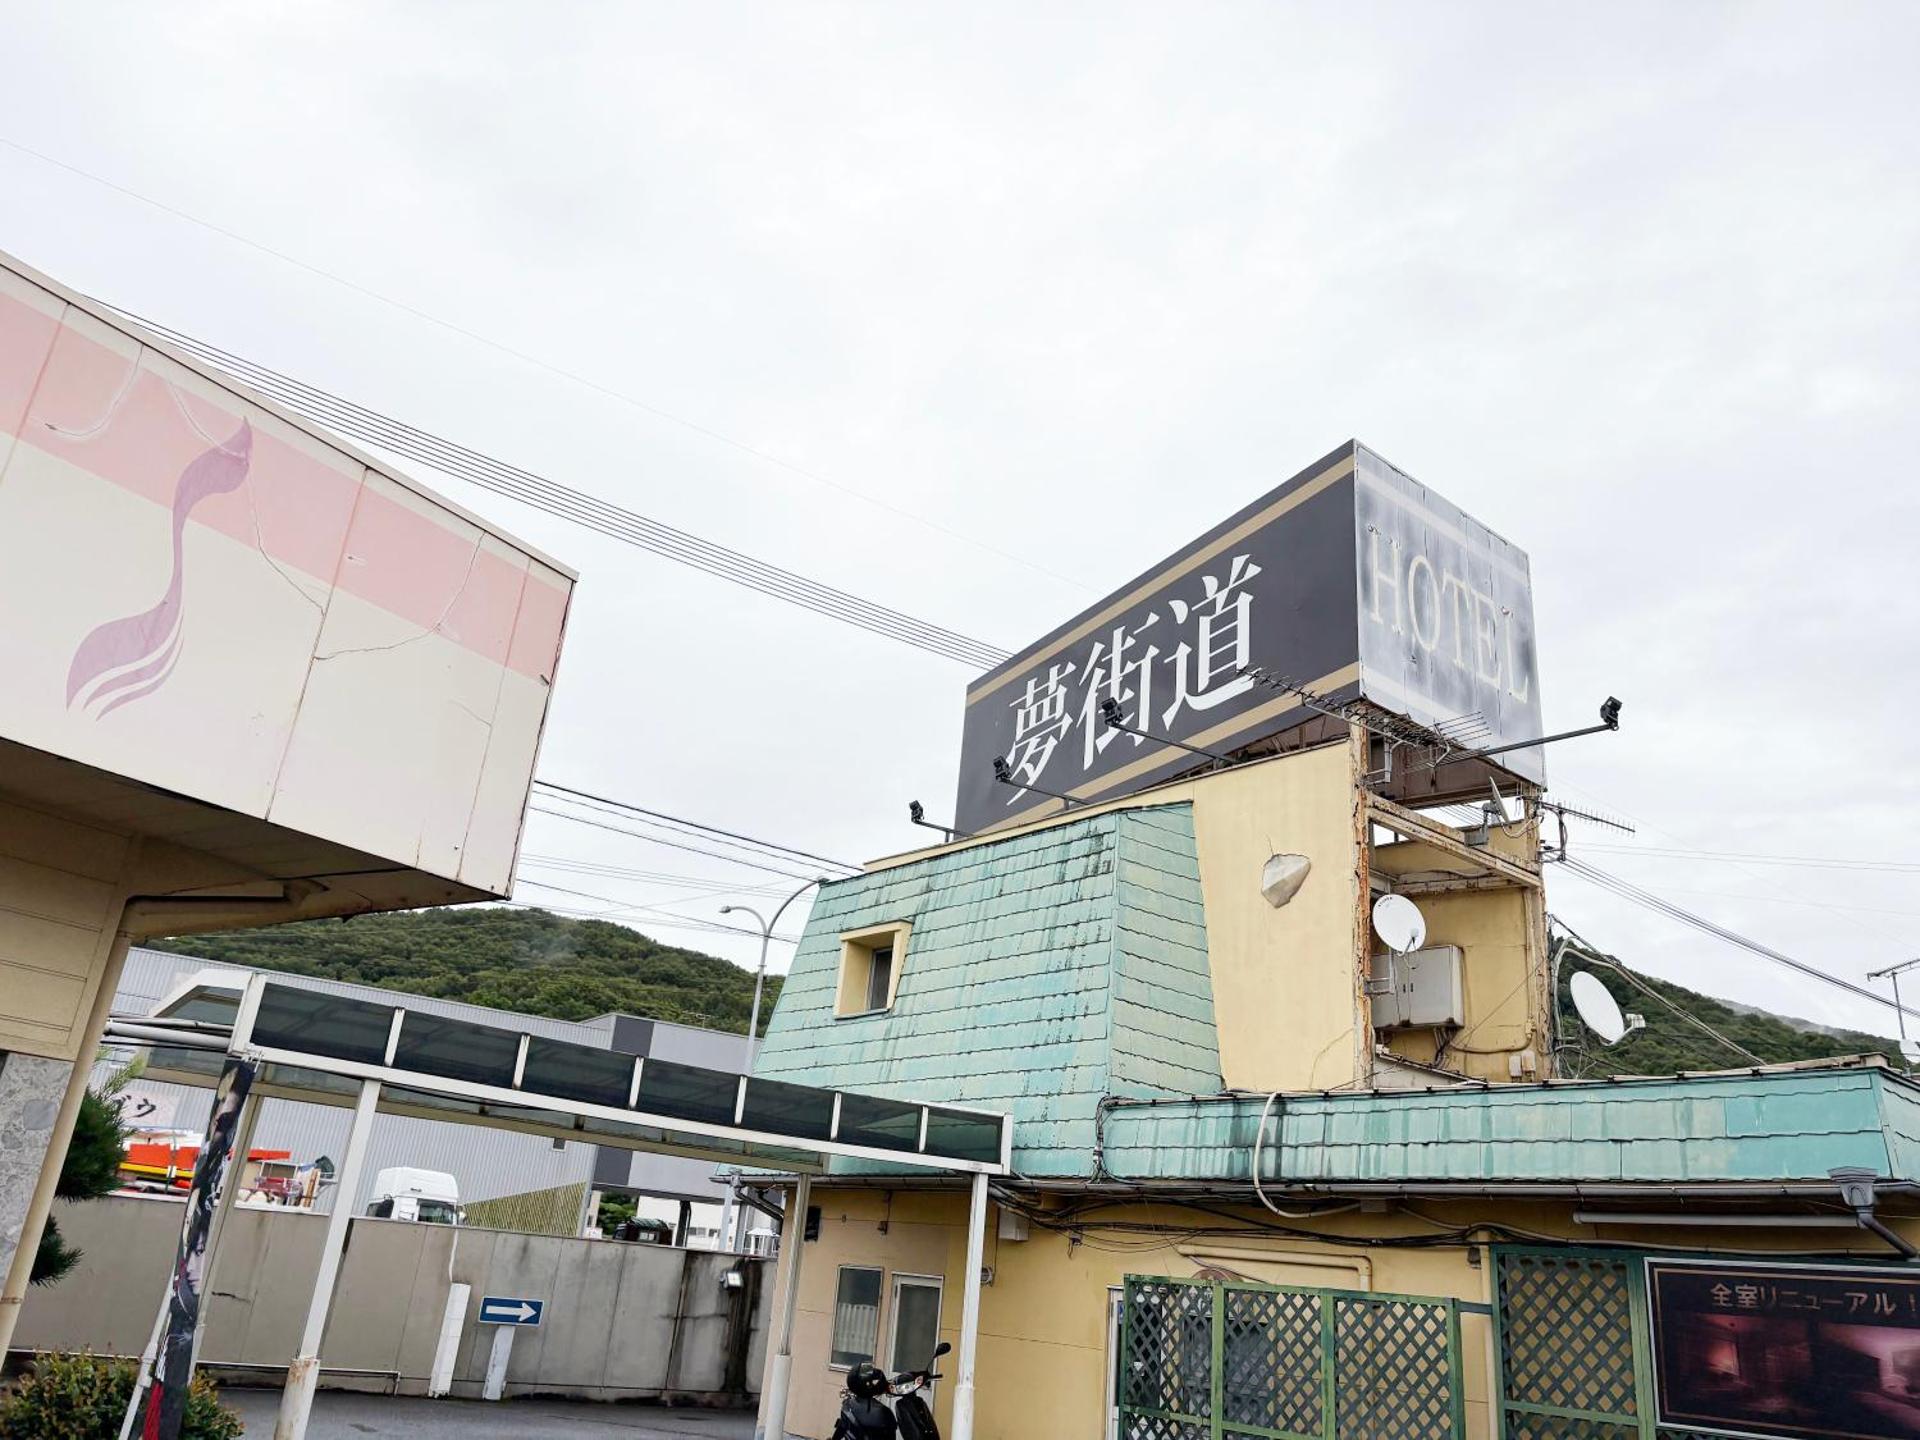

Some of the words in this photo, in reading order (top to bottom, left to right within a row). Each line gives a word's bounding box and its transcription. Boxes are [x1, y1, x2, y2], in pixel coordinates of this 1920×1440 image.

[1005, 553, 1263, 806] 夢街道
[1369, 528, 1529, 704] HOTEL
